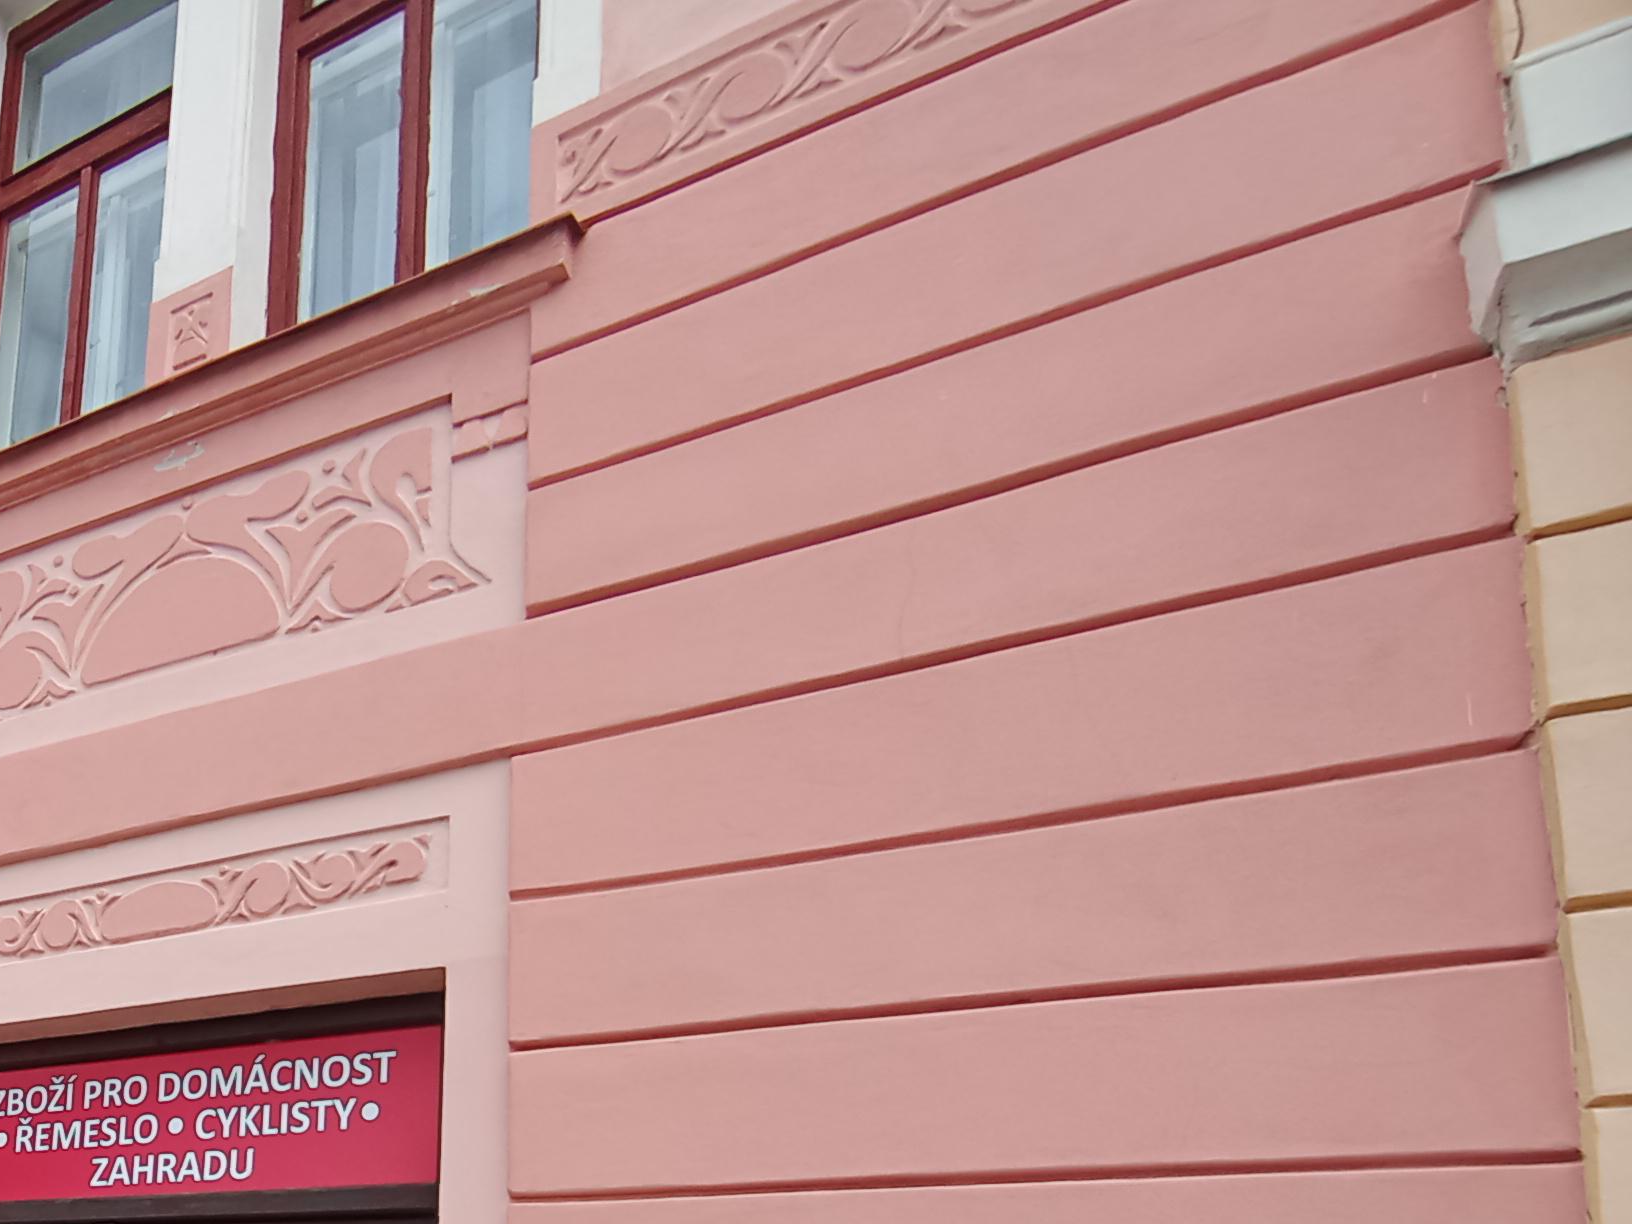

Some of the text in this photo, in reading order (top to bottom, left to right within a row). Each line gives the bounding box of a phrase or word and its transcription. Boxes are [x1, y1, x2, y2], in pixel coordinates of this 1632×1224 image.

[83, 1075, 148, 1110] PRO
[158, 1050, 397, 1104] DOMÁCNOST
[14, 1098, 358, 1153] ŘEMESLO CYKLISTY
[89, 1148, 255, 1187] ZAHRADU
